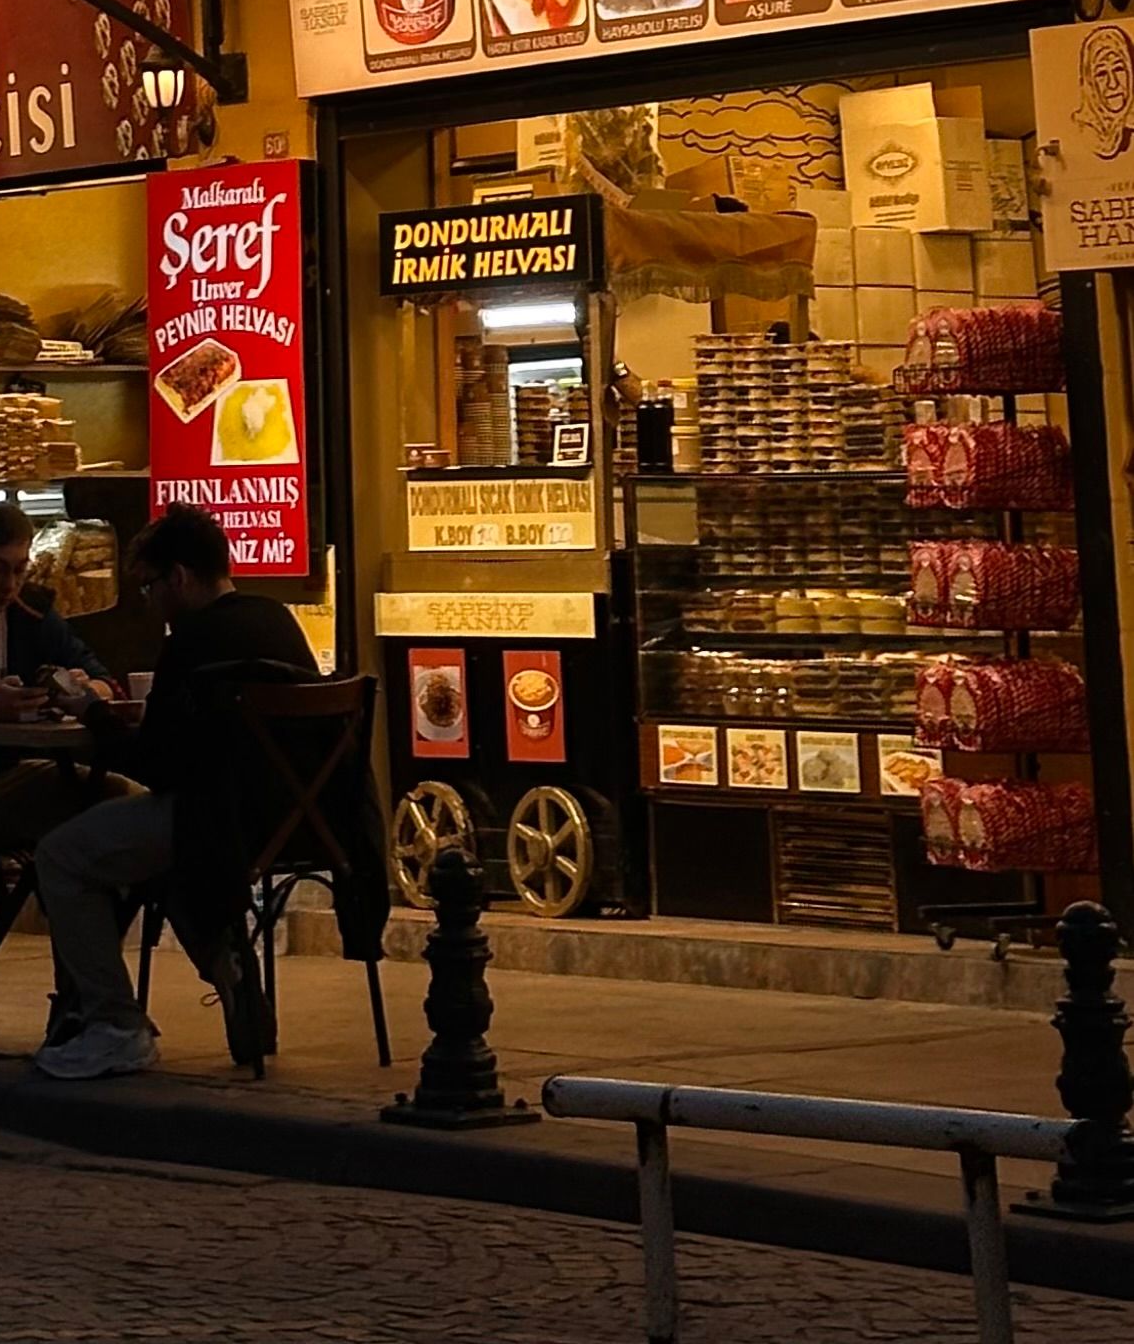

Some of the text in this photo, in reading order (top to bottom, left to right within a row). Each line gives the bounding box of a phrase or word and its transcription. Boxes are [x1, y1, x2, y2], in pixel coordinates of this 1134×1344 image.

[181, 177, 266, 210] Malkaralı
[159, 192, 288, 300] Şeref
[393, 208, 573, 251] DONDURMALI
[392, 243, 577, 285] İRMİK HELVASI
[155, 302, 296, 354] PEYNİR HELVASI
[155, 476, 299, 509] FIRINLANMIŞ
[223, 510, 282, 529] HELVASI
[434, 525, 474, 546] K.BOY
[506, 524, 546, 545] B.BOY
[262, 533, 296, 564] Mİ?
[435, 616, 530, 632] HANIM
